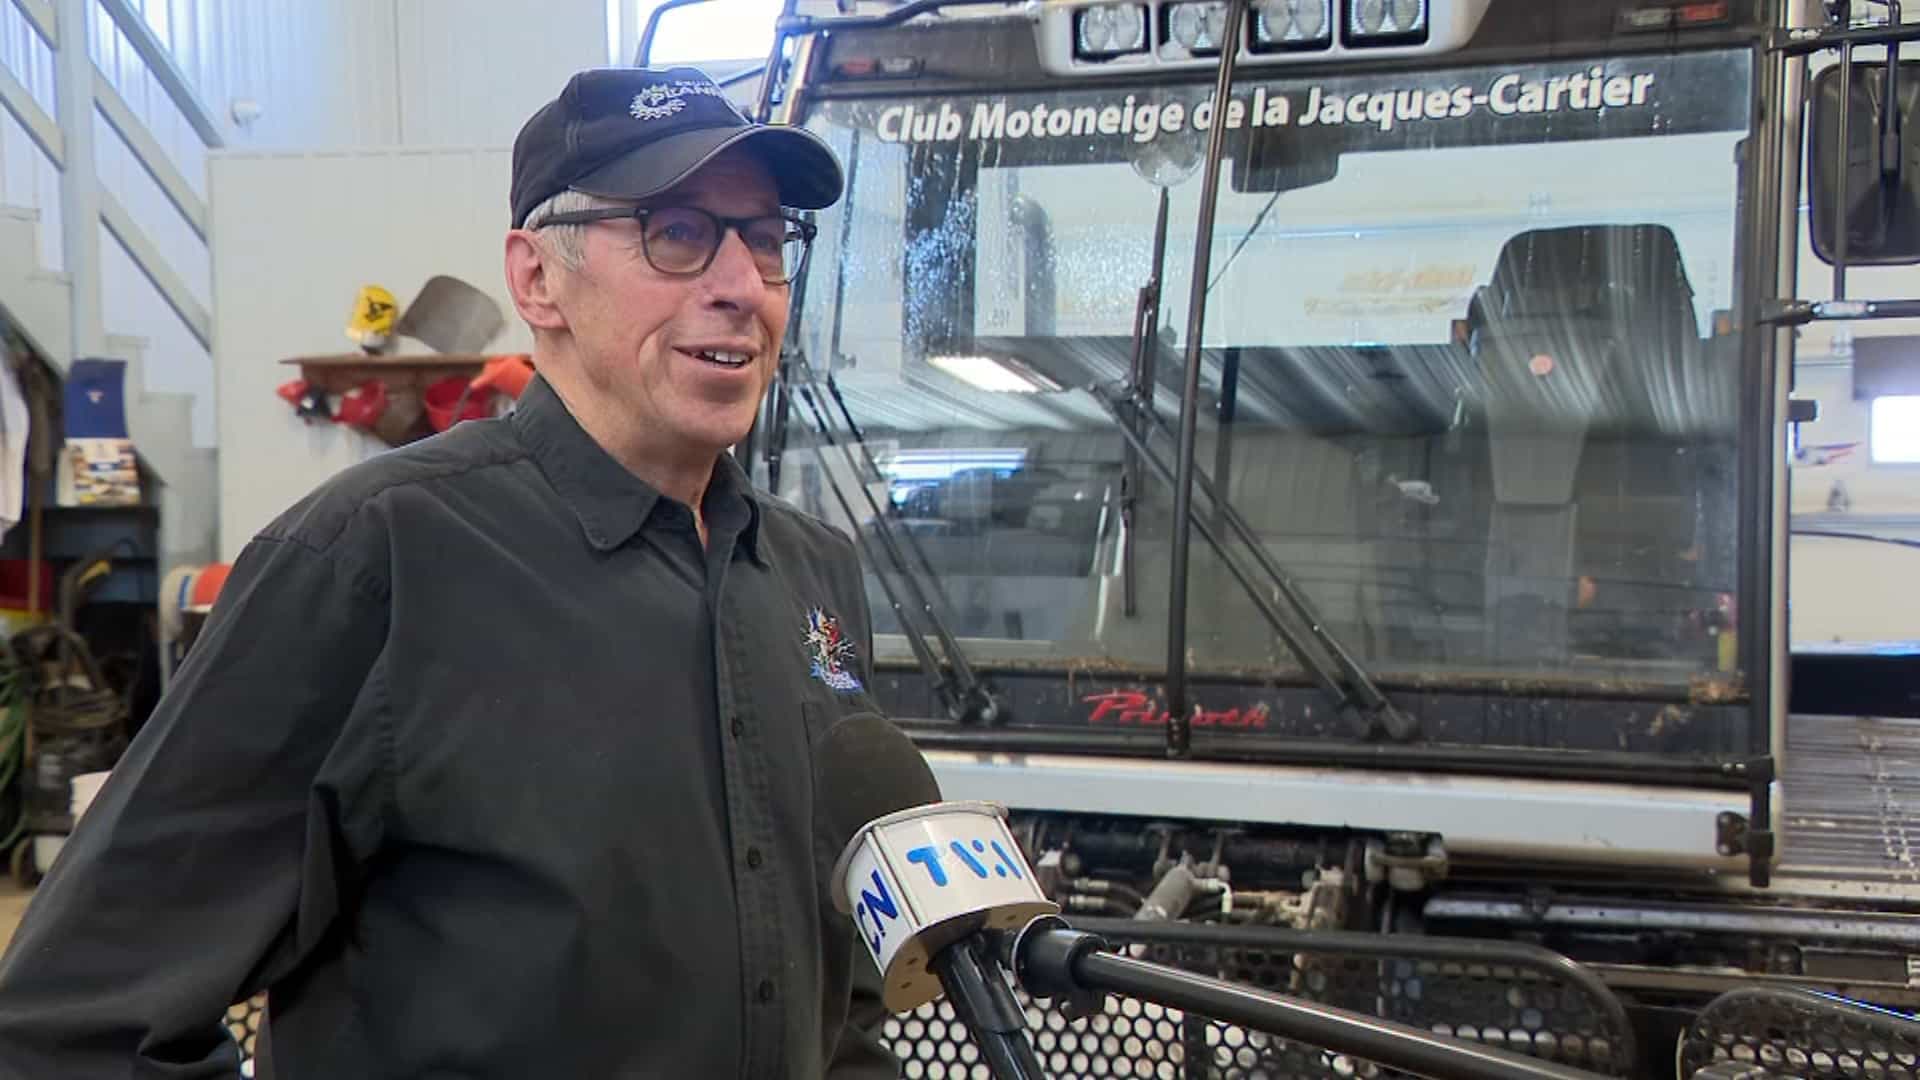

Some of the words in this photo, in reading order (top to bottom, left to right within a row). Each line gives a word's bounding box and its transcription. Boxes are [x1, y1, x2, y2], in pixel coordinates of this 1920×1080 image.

[877, 104, 961, 142] Club
[969, 95, 1185, 142] Motoneige
[1193, 91, 1245, 131] de
[1252, 87, 1290, 127] la
[1298, 67, 1653, 131] Jacques-Cartier
